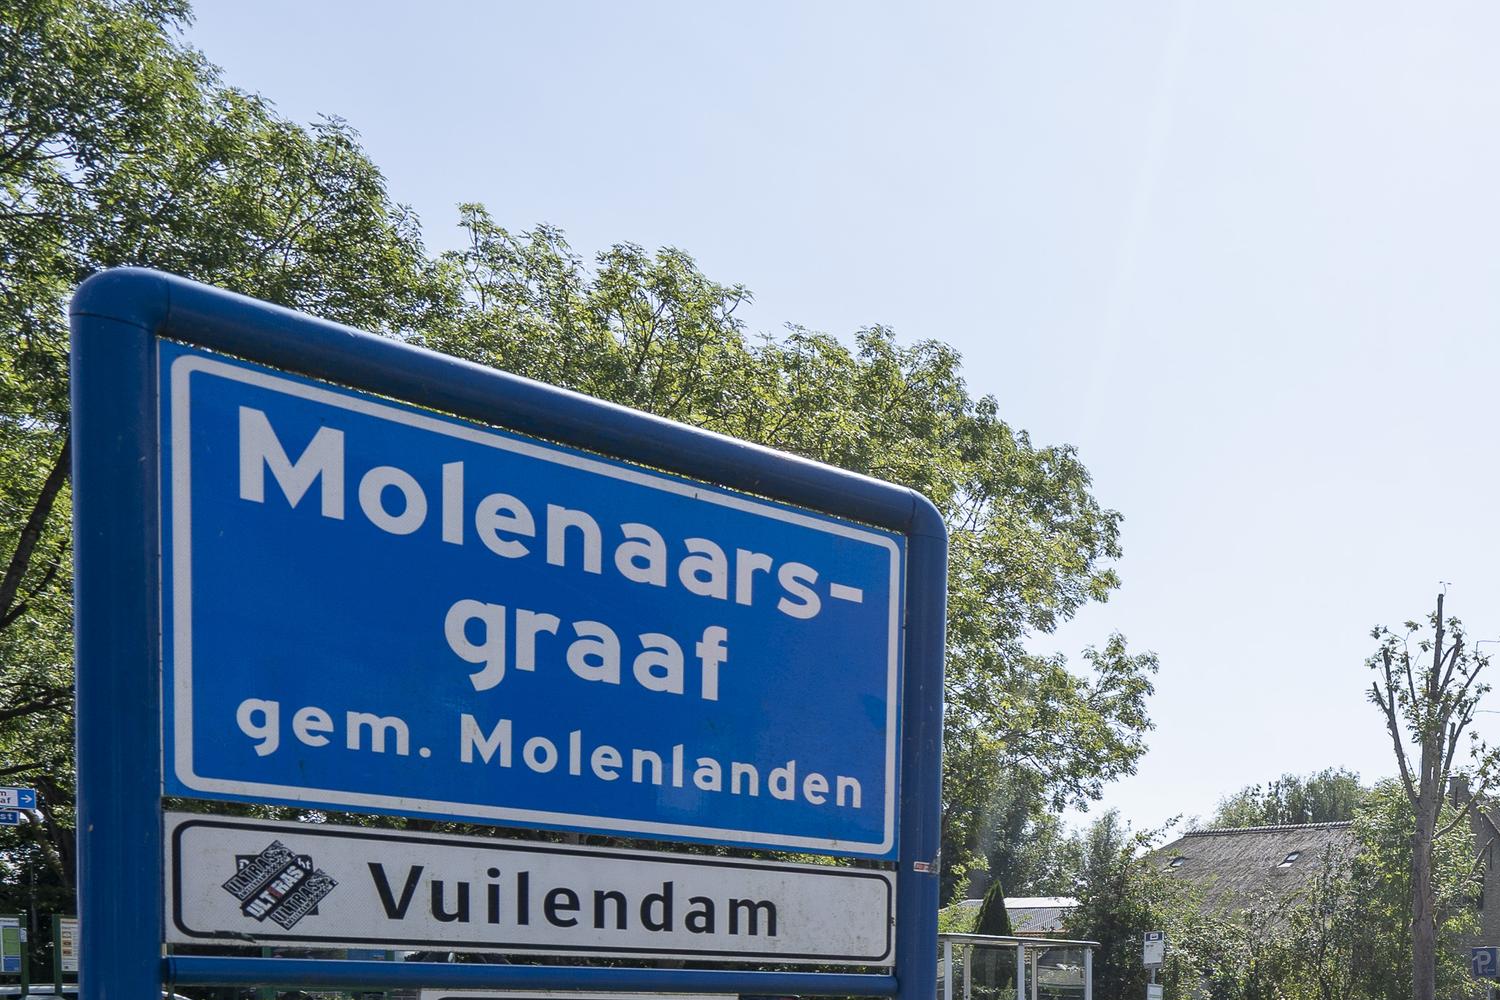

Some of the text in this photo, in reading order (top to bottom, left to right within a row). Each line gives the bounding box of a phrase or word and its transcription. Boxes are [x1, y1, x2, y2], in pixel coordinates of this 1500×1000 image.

[240, 407, 864, 619] Molenaars-
[445, 599, 728, 701] graaf
[237, 699, 862, 809] gem. Molenlanden
[368, 862, 777, 937] Vuilendam
